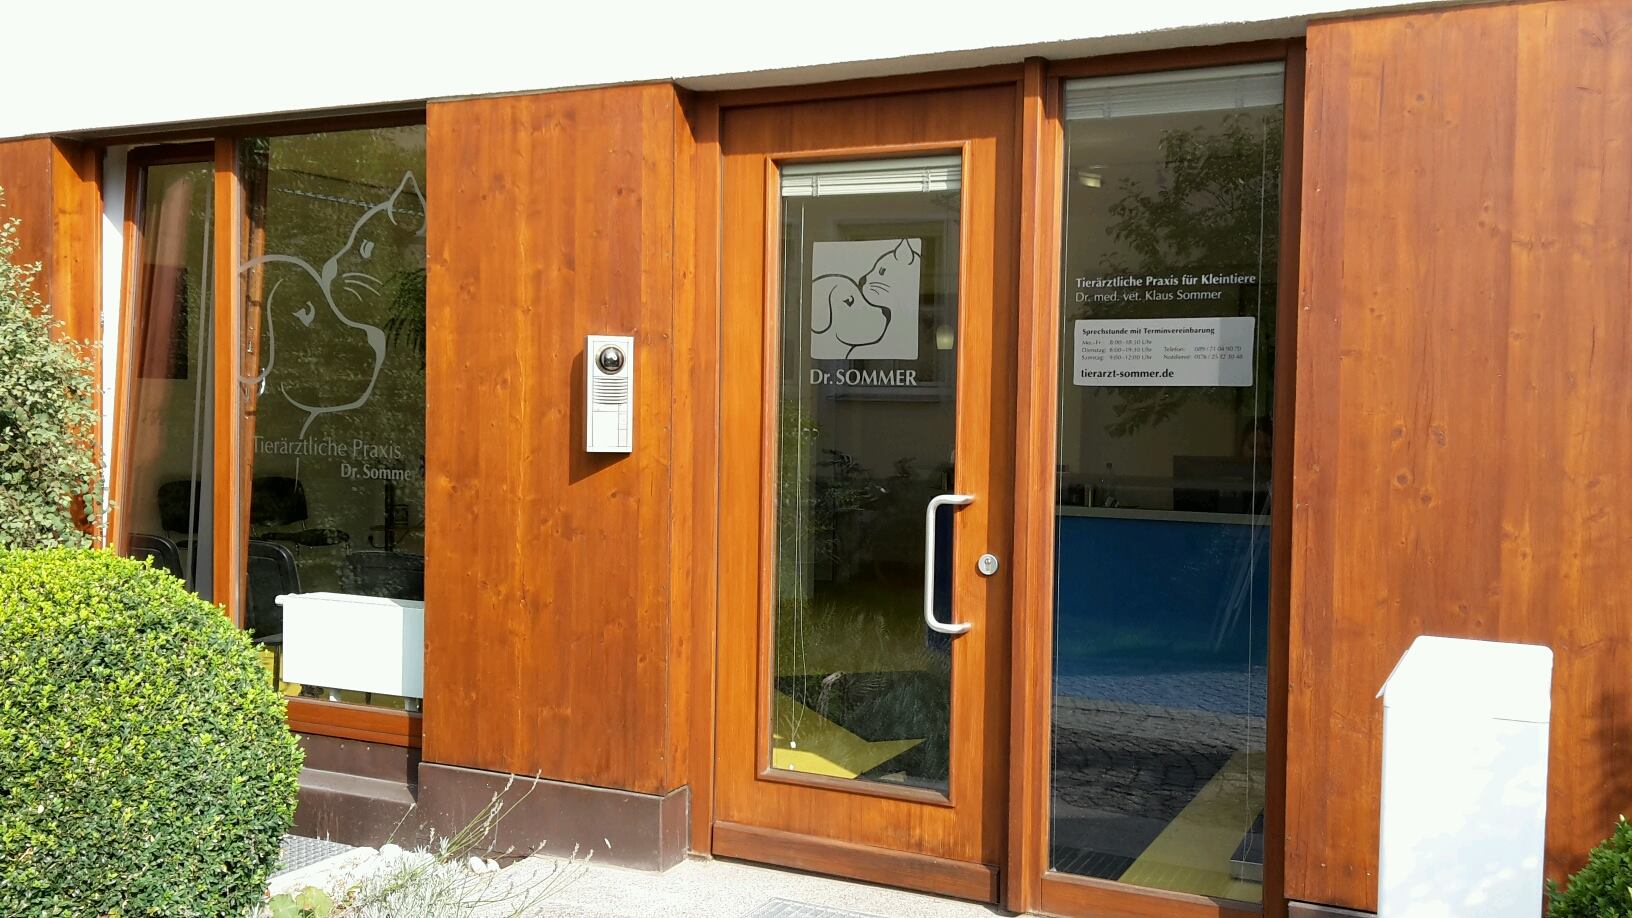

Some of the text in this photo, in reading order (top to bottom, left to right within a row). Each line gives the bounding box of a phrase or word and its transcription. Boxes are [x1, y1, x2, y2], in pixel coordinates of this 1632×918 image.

[1076, 273, 1256, 288] Tierärztliche Praxis für Kleintiere
[1075, 290, 1222, 302] Dr. med. vet. Klaus Sommer
[1082, 328, 1128, 336] Sprechstunde
[1144, 327, 1215, 335] Terminvereinbarung
[810, 369, 917, 386] Dr. SOMMER
[1081, 368, 1174, 378] tierarzt-sommer.de
[253, 435, 402, 460] Tierärztliche Praxis
[341, 463, 360, 478] Dr.
